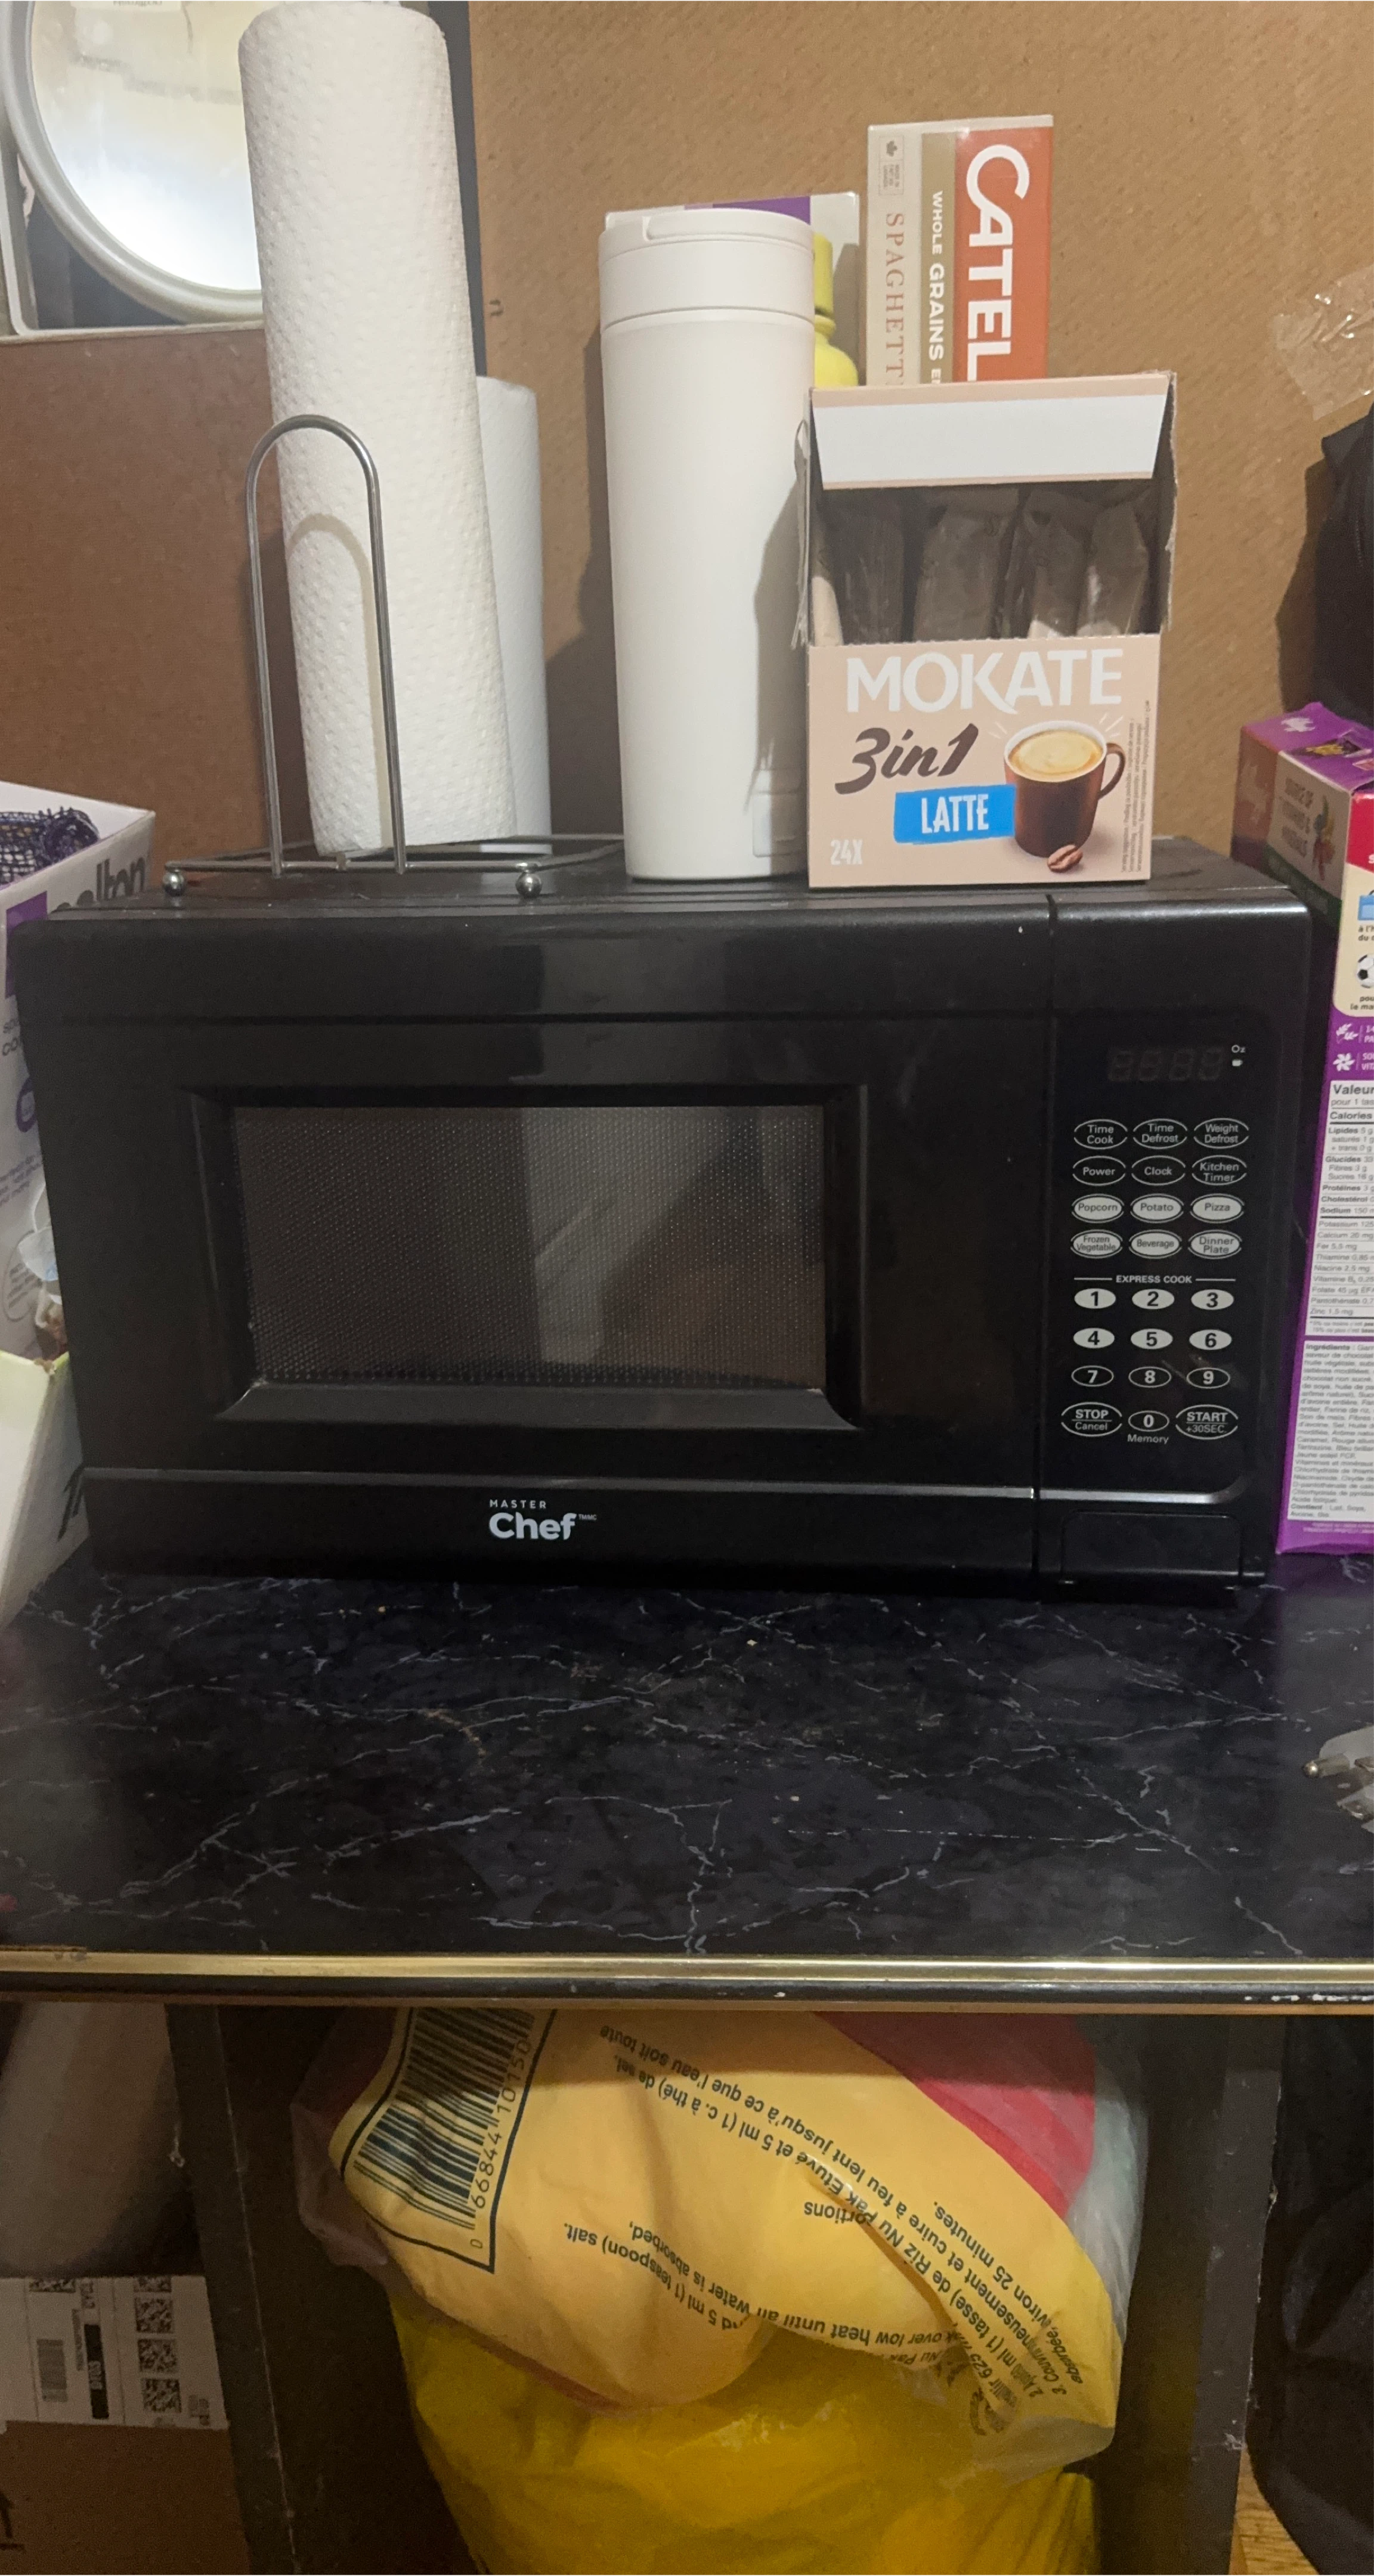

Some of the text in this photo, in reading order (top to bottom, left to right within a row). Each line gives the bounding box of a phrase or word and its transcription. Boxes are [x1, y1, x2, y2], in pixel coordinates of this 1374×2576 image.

[932, 190, 943, 255] WHOLE
[886, 213, 904, 385] SPAGHETT
[929, 262, 944, 361] GRAINS
[846, 648, 1124, 714] MOKATE
[835, 723, 979, 795] 3in1
[921, 793, 989, 834] LATTE
[831, 839, 863, 865] 24X
[57, 857, 146, 909] lton
[1231, 1045, 1245, 1054] Oz
[1330, 1111, 1373, 1120] Calories
[1087, 1125, 1114, 1134] Time
[1147, 1123, 1174, 1132] Time
[1205, 1124, 1238, 1135] Weight
[1087, 1135, 1113, 1144] Cook
[1141, 1134, 1178, 1144] Defrost
[1205, 1135, 1238, 1144] Defrost
[1083, 1167, 1115, 1176] Power
[1144, 1166, 1172, 1175] Clock
[1200, 1162, 1239, 1172] Kitchen
[1203, 1172, 1234, 1182] Timer
[1078, 1203, 1118, 1213] Popcorn
[1140, 1203, 1173, 1212] Potato
[1205, 1203, 1230, 1212] Pizza
[1076, 1243, 1116, 1253] Vegetable
[1137, 1239, 1174, 1250] Beverage
[1199, 1237, 1234, 1245] Dinner
[1203, 1245, 1229, 1254] Plate
[1116, 1275, 1193, 1284] EXPRESS COOK
[1090, 1291, 1098, 1306] 1
[1147, 1291, 1159, 1307] 2
[1206, 1292, 1218, 1308] 3
[1088, 1331, 1100, 1346] 4
[1146, 1332, 1158, 1346] 5
[1205, 1333, 1217, 1348] 6
[1087, 1370, 1098, 1383] 7
[1144, 1370, 1156, 1384] 8
[1203, 1371, 1214, 1385] 9
[1075, 1409, 1109, 1419] STOP
[1143, 1414, 1154, 1428] 0
[1187, 1411, 1228, 1422] START
[1075, 1422, 1108, 1431] Cancel
[1128, 1434, 1169, 1444] Memory
[489, 1499, 547, 1509] MASTER
[489, 1511, 577, 1540] Chef
[600, 2025, 637, 2053] toute
[639, 2042, 670, 2066] soit
[639, 2071, 655, 2089] de
[671, 2059, 709, 2089] l'eau
[658, 2077, 688, 2109] thé)
[711, 2079, 742, 2101] que
[692, 2097, 701, 2116] à
[706, 2103, 718, 2120] c.
[744, 2095, 765, 2113] ce
[721, 2111, 738, 2133] (1
[768, 2106, 834, 2155] jusqu'à
[739, 2121, 760, 2141] ml
[762, 2134, 774, 2151] 5
[776, 2140, 794, 2157] et
[471, 2131, 503, 2210] 66844
[832, 2148, 867, 2182] lent
[867, 2176, 894, 2207] feu
[896, 2201, 908, 2219] à
[878, 2219, 905, 2248] Nu
[909, 2214, 948, 2255] cuire
[629, 2221, 690, 2277] absorbed,
[933, 2202, 1014, 2290] 25 minutes.
[903, 2243, 932, 2275] Riz
[947, 2250, 964, 2271] et
[564, 2222, 717, 2326] 5 ml (1 teaspoon) salt.
[694, 2271, 705, 2292] is
[933, 2270, 952, 2293] de
[708, 2282, 751, 2314] water
[949, 2289, 990, 2339] tasse)
[783, 2313, 825, 2333] until
[831, 2323, 871, 2346] heat
[875, 2330, 905, 2346] low
[908, 2332, 942, 2346] over
